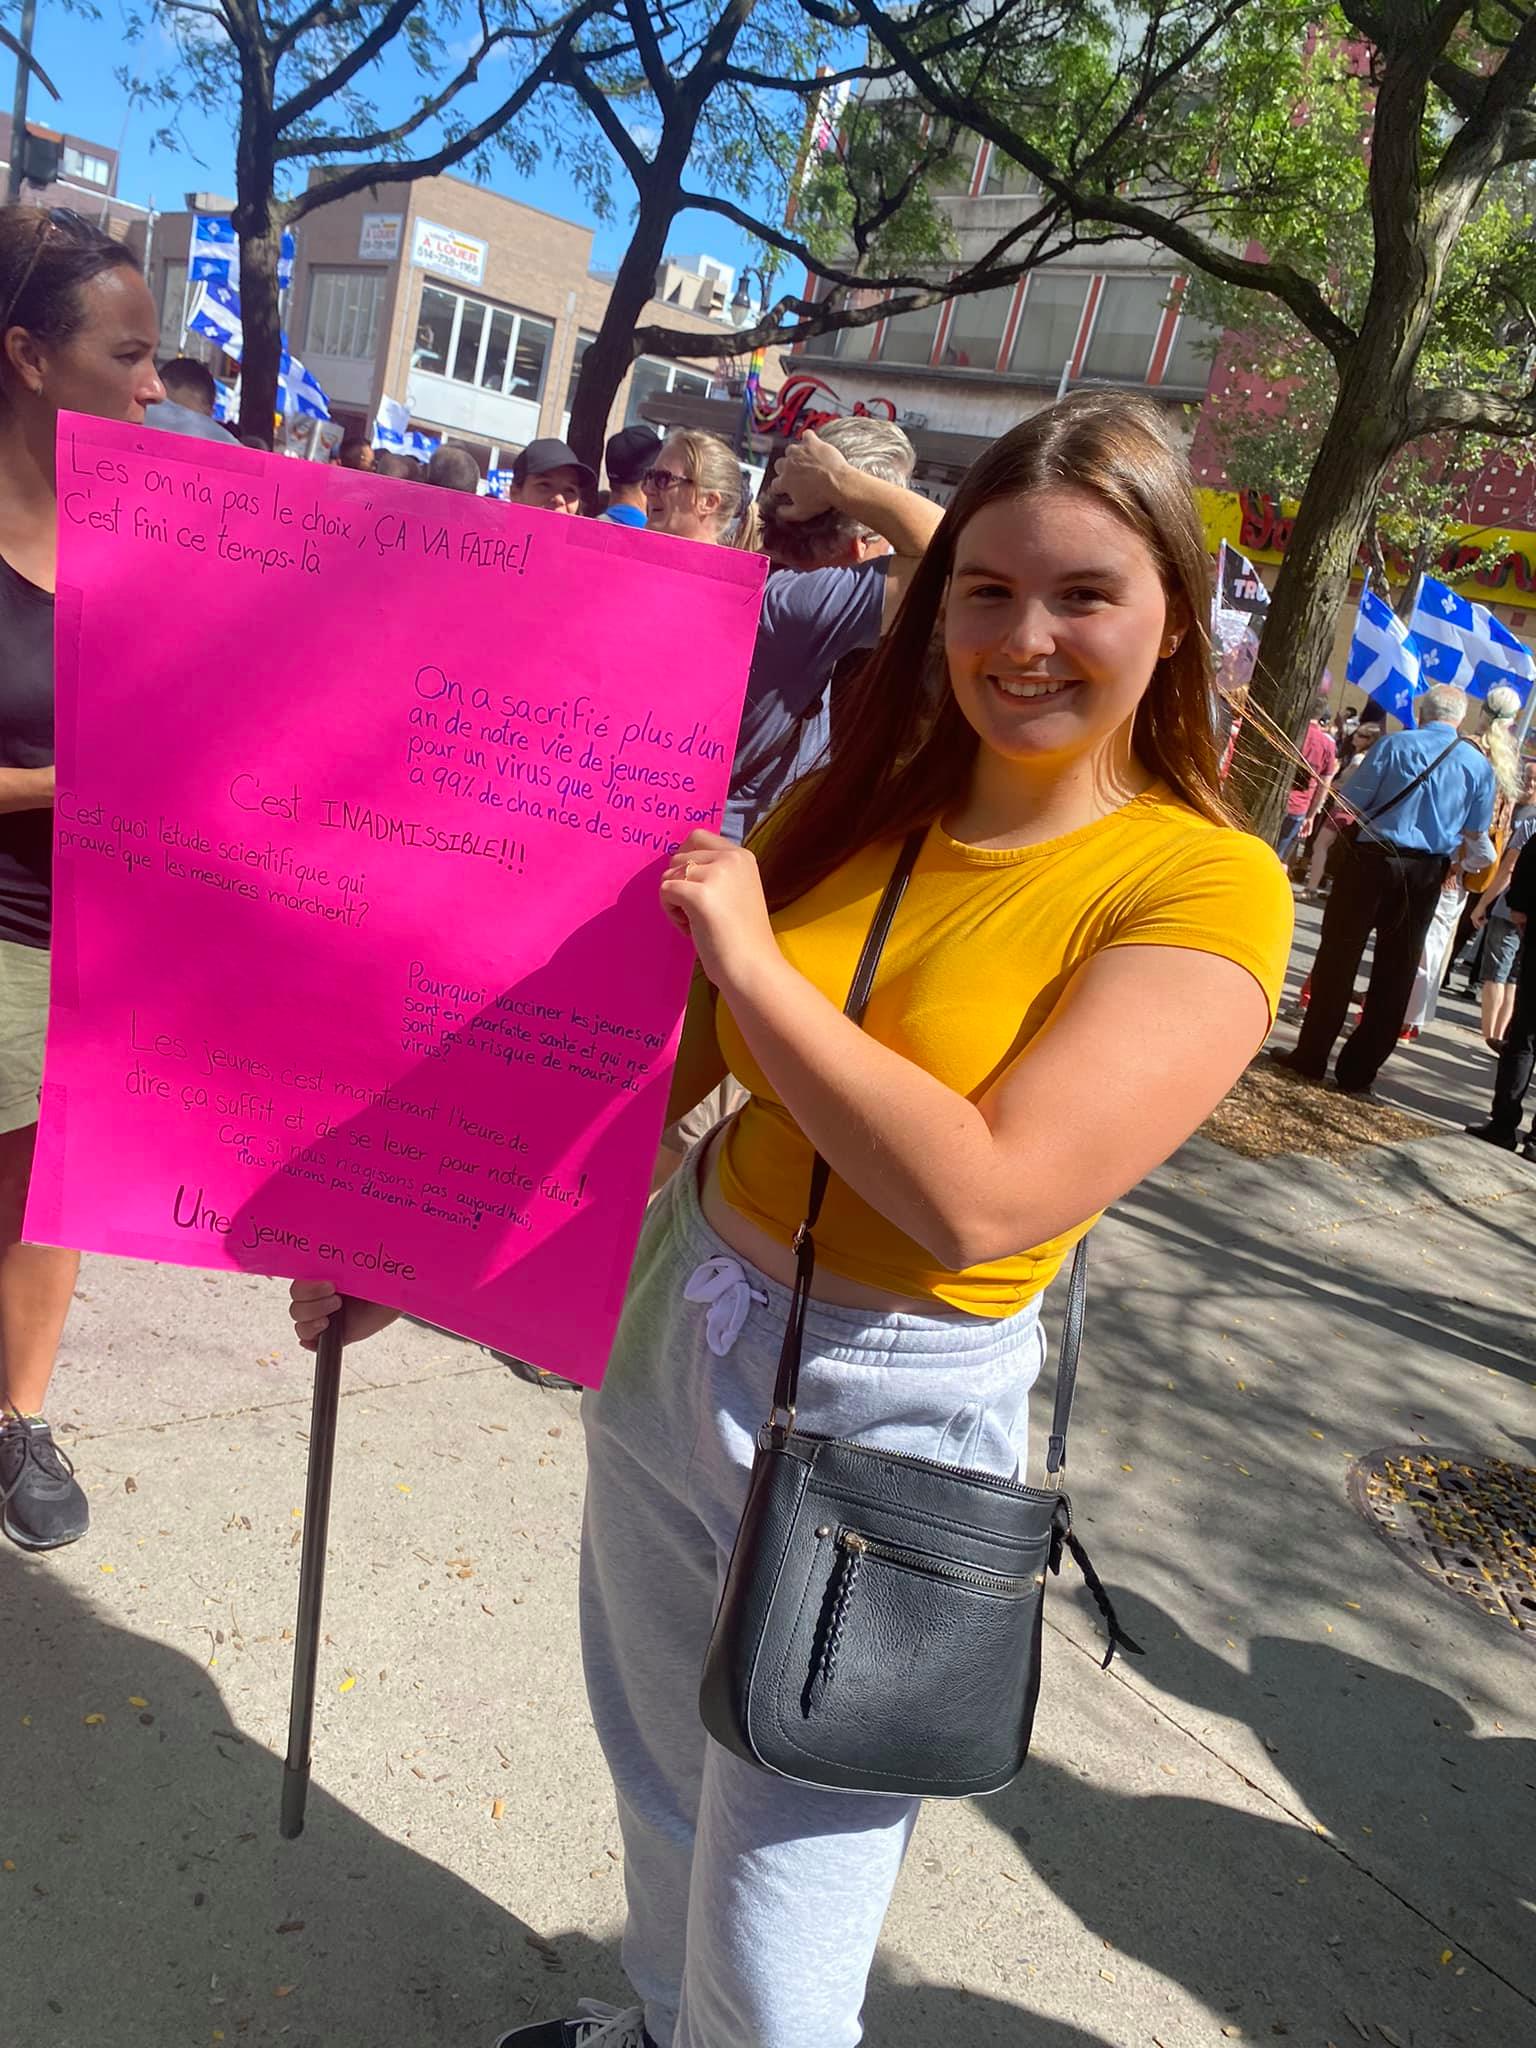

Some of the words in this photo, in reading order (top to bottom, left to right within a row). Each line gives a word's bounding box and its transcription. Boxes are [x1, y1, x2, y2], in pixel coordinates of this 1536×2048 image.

[436, 240, 478, 263] LOUER
[64, 489, 122, 534] C'est
[134, 506, 168, 543] fini
[177, 527, 206, 552] ce
[72, 432, 129, 484] Les
[222, 490, 259, 524] pas
[273, 483, 293, 525] le
[375, 514, 406, 556] ÇA
[421, 525, 450, 560] VA
[460, 530, 533, 575] FAIRE!
[409, 706, 437, 730] an
[444, 709, 473, 738] de
[480, 719, 529, 750] notre
[541, 733, 573, 763] vie
[579, 742, 603, 771] de
[602, 754, 696, 793] jeunesse
[415, 665, 464, 705] On
[471, 687, 491, 710] a
[500, 696, 609, 738] sacrifié
[618, 710, 673, 754] plus
[679, 722, 725, 763] d'un
[230, 773, 302, 822] C'est
[319, 800, 526, 874] INADMISSIBLE!!!
[406, 735, 455, 763] pour
[464, 747, 486, 770] un
[496, 753, 551, 787] virus
[557, 775, 594, 809] que
[607, 783, 635, 813] l'on
[641, 796, 679, 822] s'en
[683, 801, 722, 825] sort
[432, 767, 475, 799] 99%
[479, 781, 503, 807] de
[507, 791, 581, 828] chance
[585, 813, 612, 839] de
[622, 825, 681, 857] survie
[58, 791, 105, 826] C'est
[111, 815, 148, 849] quoi
[218, 841, 330, 892] scientifique
[337, 873, 366, 906] qui
[58, 829, 116, 858] prouve
[122, 850, 152, 873] que
[164, 852, 186, 878] les
[190, 865, 259, 899] mesures
[268, 888, 369, 927] marchent?
[408, 960, 487, 1008] Pourquoi
[495, 994, 564, 1020] vacciner
[570, 1008, 589, 1029] les
[591, 1015, 641, 1041] jeunes
[644, 1032, 665, 1049] qui
[443, 1009, 466, 1024] en
[471, 1017, 532, 1042] parfaite
[538, 1031, 578, 1053] santé
[580, 1042, 597, 1060] et
[600, 1052, 622, 1068] qui
[626, 1058, 649, 1076] ne
[131, 1009, 188, 1059] Les
[334, 1080, 439, 1120] maintenant
[449, 1105, 505, 1145] l'heure
[509, 1135, 529, 1154] de
[401, 1038, 451, 1063] virus?
[440, 1030, 462, 1048] pas
[480, 1040, 536, 1066] risque
[541, 1053, 563, 1071] de
[568, 1062, 618, 1085] mourir
[620, 1075, 640, 1093] du
[126, 1059, 170, 1098] dire
[181, 1086, 208, 1111] ça
[215, 1092, 275, 1122] suffit
[284, 1106, 305, 1131] et
[315, 1117, 338, 1139] de
[348, 1130, 371, 1149] se
[383, 1130, 429, 1161] lever
[438, 1154, 480, 1175] pour
[488, 1165, 534, 1191] notre
[538, 1174, 588, 1207] futur!
[219, 1124, 256, 1146] Car
[266, 1138, 280, 1154] si
[290, 1143, 327, 1165] nous
[422, 1182, 448, 1200] pas
[173, 1184, 232, 1235] Une
[242, 1216, 309, 1251] jeune
[318, 1243, 345, 1264] en
[353, 1243, 416, 1281] colère
[330, 1177, 353, 1191] pas
[361, 1181, 416, 1208] d'avenir
[422, 1201, 481, 1230] demain!
